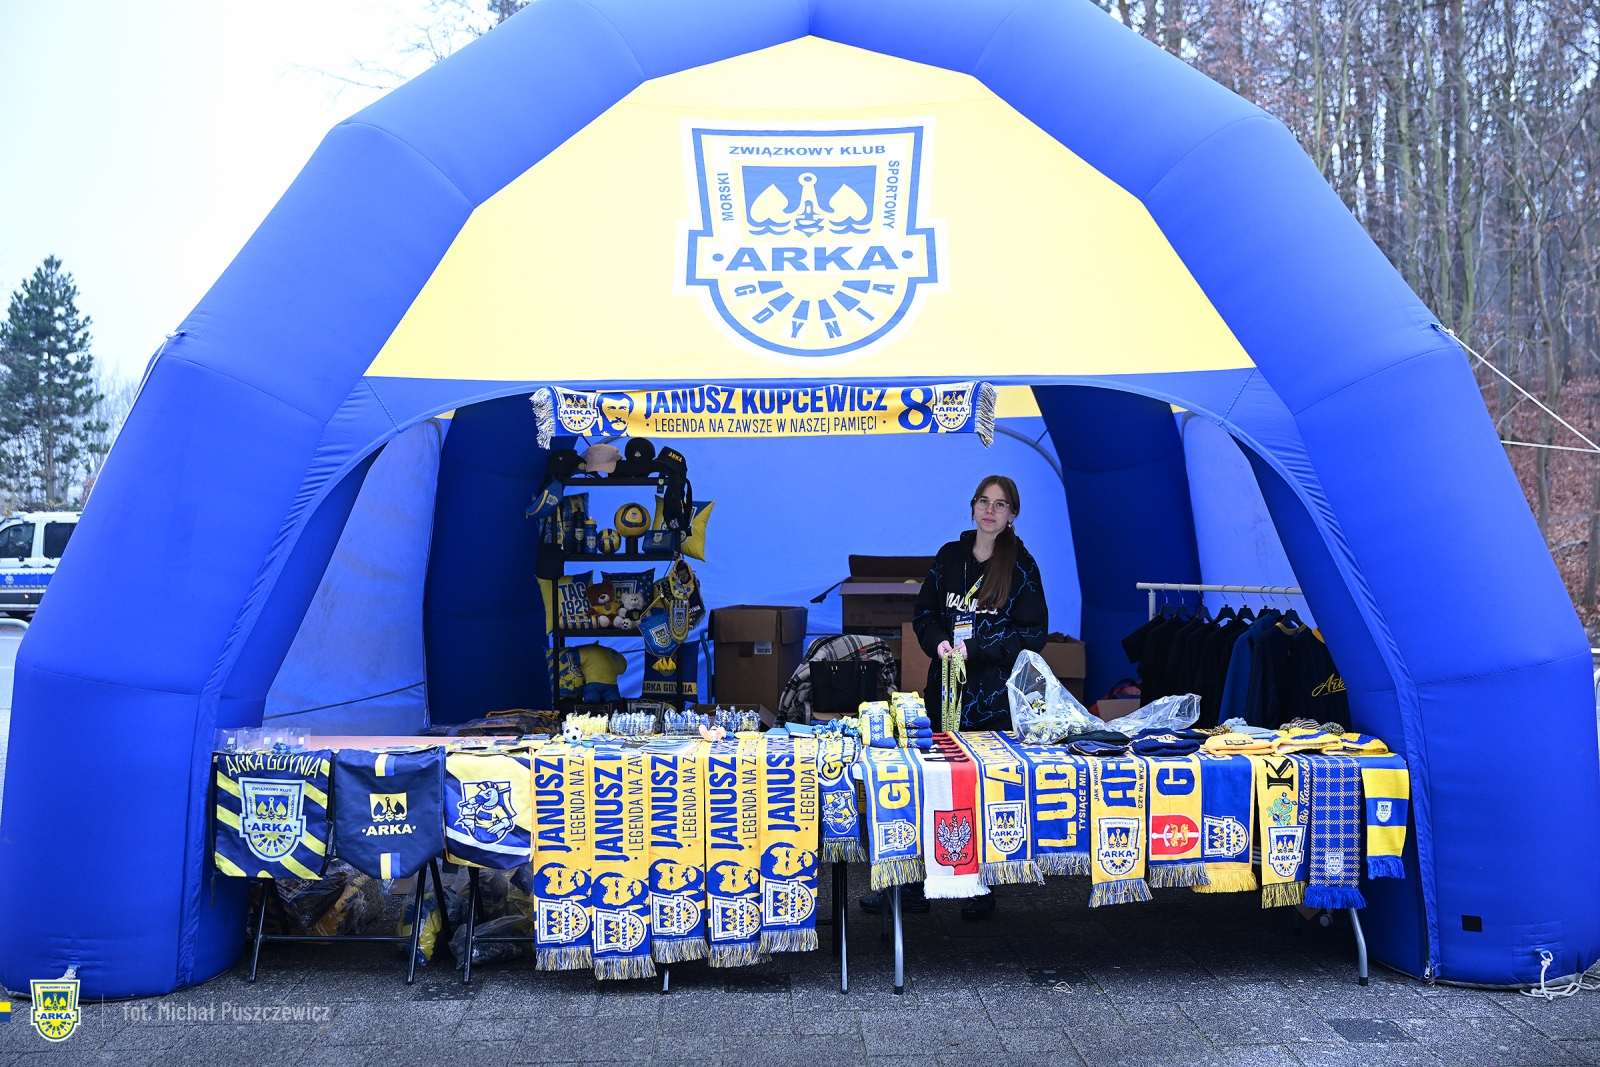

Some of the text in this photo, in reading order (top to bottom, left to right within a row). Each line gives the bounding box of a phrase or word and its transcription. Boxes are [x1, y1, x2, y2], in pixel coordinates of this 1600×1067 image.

[729, 145, 886, 157] ZWIĄZKOWY KLUB
[717, 172, 734, 221] MORSKI
[882, 160, 900, 229] SPORTOWY
[725, 246, 899, 271] ARKA
[734, 279, 896, 339] GDYNIA
[644, 385, 888, 419] JANUSZ KUPCEWICZ
[898, 387, 934, 430] 8
[654, 416, 877, 434] LEGENDA NA ZAWSZE W NASZEJ PAMIĘCI
[560, 599, 591, 616] 1929
[225, 755, 321, 778] ARKA GDYNIA
[569, 769, 585, 786] NA
[682, 767, 697, 783] NA
[742, 769, 757, 785] NA
[534, 757, 572, 853] JANUSZ
[628, 778, 643, 795] NA
[651, 755, 684, 849] JANUSZ
[708, 756, 745, 851] JANUSZ
[800, 769, 816, 821] LEGENDA
[1138, 782, 1144, 793] NA
[251, 823, 294, 832] ARKA
[569, 789, 586, 842] LEGENDA
[594, 766, 630, 863] JANUSZ
[628, 798, 644, 851] LEGENDA
[682, 787, 697, 839] LEGENDA
[742, 788, 757, 840] LEGENDA
[1079, 789, 1088, 831] TYSIĄCE
[365, 824, 413, 836] ARKA
[1104, 850, 1133, 858] ARKA
